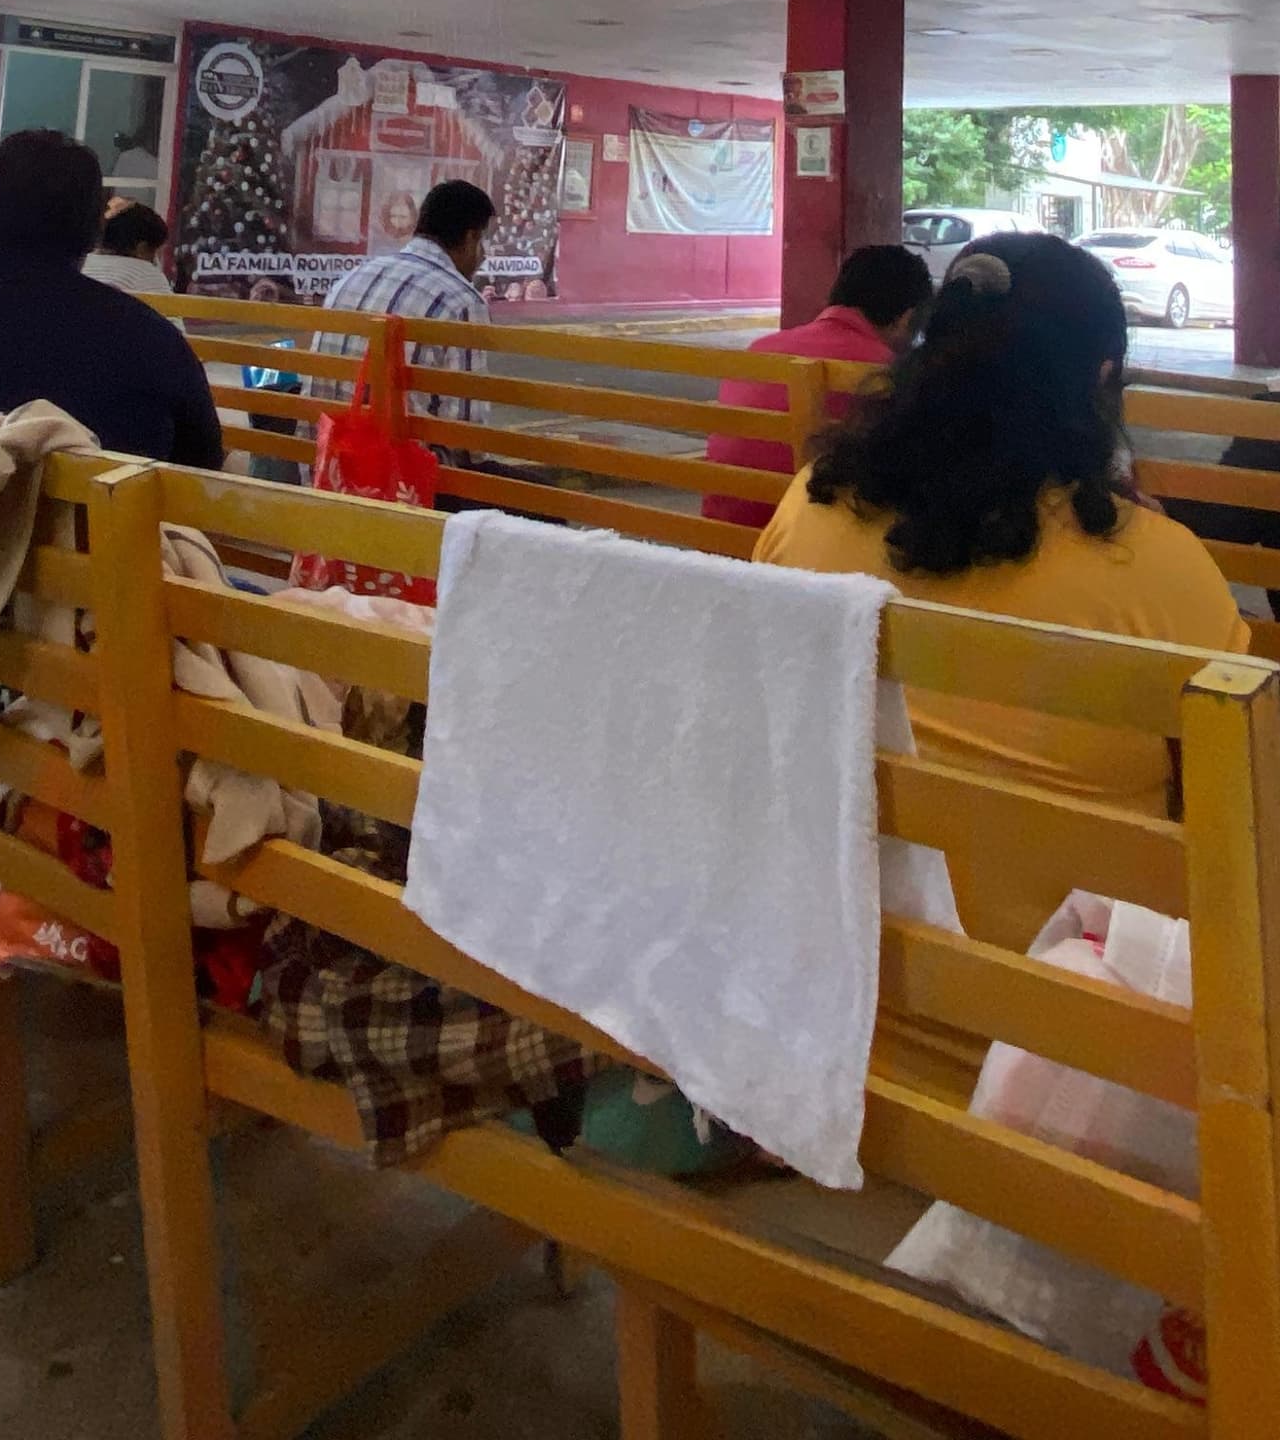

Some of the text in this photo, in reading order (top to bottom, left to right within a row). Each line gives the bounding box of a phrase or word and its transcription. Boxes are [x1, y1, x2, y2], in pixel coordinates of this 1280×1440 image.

[201, 257, 222, 270] LA
[226, 257, 292, 271] FAMILIA
[488, 260, 538, 271] NAVIDAD
